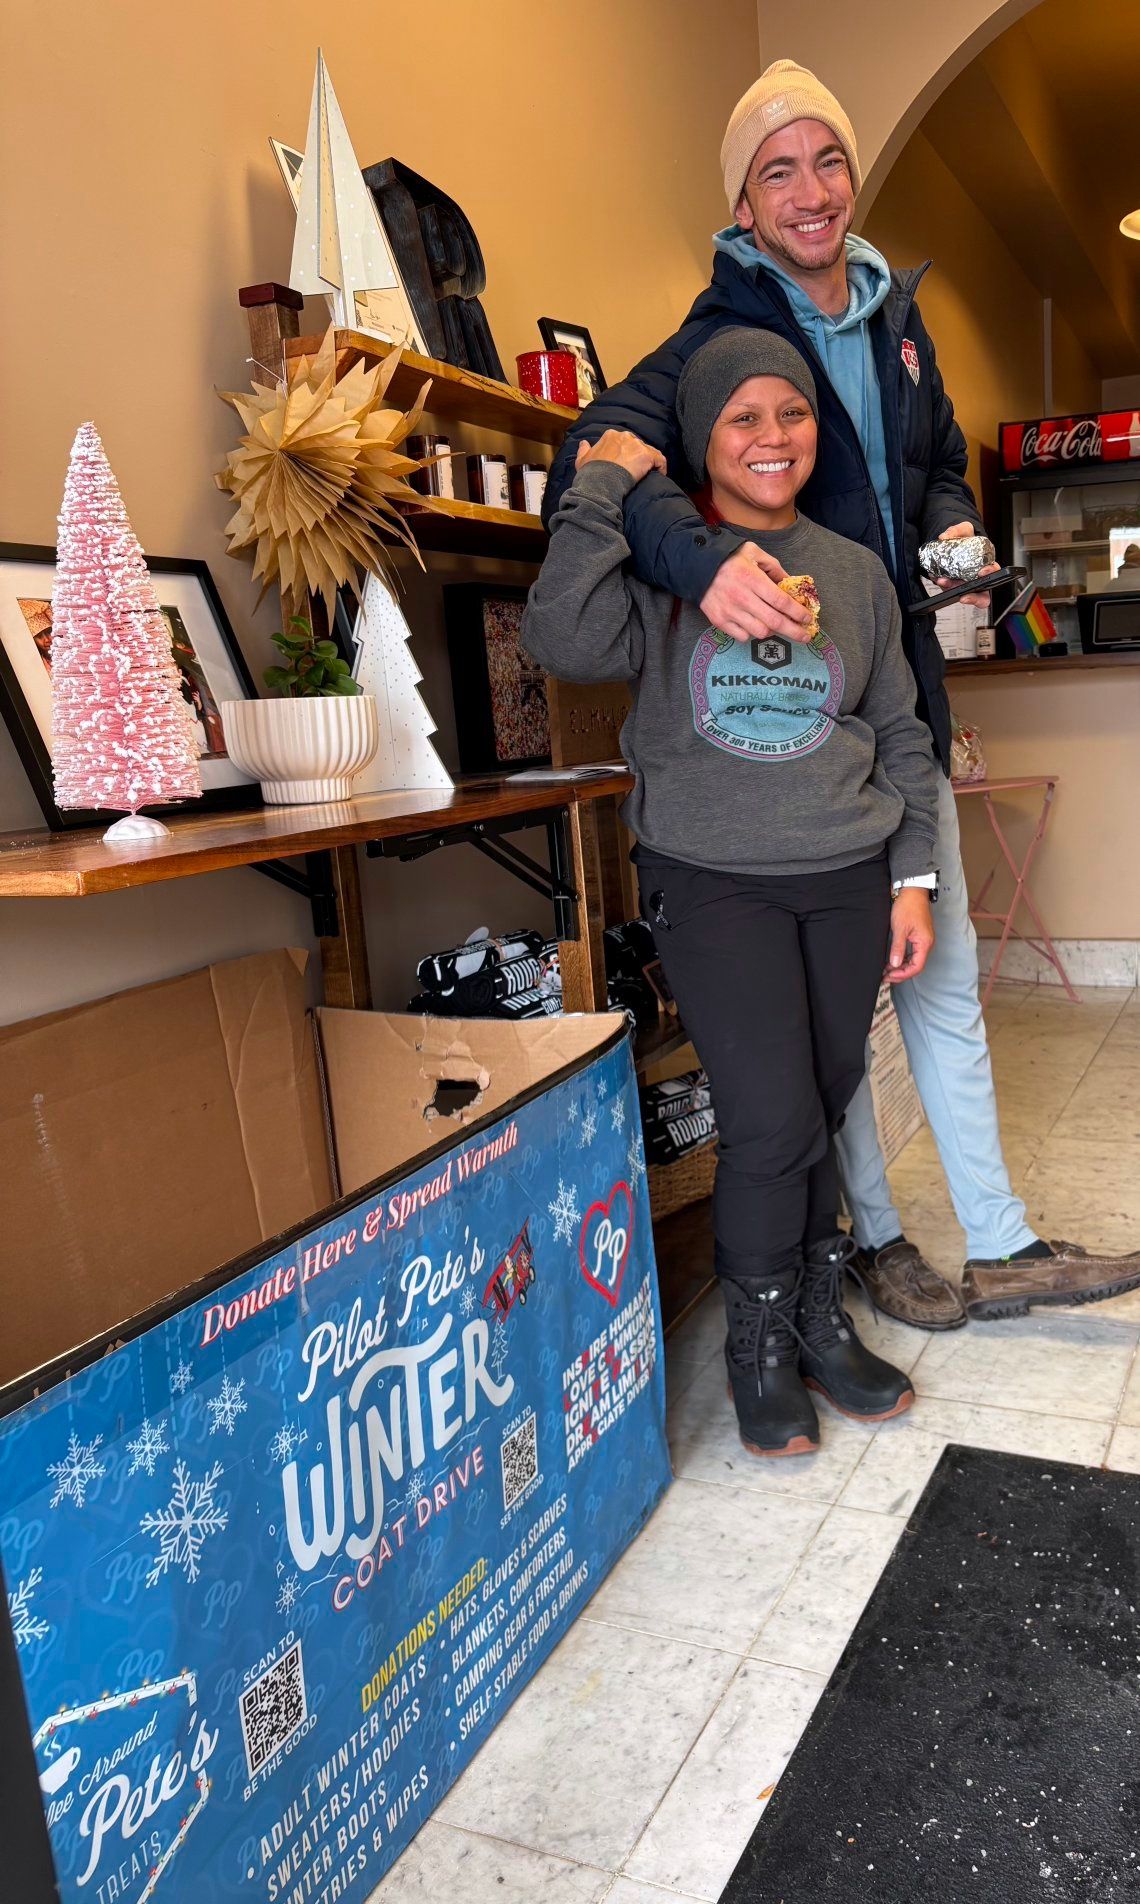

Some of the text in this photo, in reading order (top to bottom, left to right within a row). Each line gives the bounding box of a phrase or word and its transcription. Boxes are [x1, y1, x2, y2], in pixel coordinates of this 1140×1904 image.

[1021, 420, 1102, 466] Coca-Cola
[707, 724, 728, 741] OVER
[729, 737, 745, 748] 300
[748, 742, 777, 753] YEARS
[780, 742, 792, 752] OF
[794, 713, 831, 748] EXCELLENC
[711, 675, 828, 694] KIKKOMAN
[720, 691, 779, 702] NATURALLY
[200, 1121, 518, 1348] Donate Here & Spread Warmth
[297, 1224, 486, 1403] Pilot Pete's
[282, 1312, 515, 1572] WINTER
[502, 1405, 532, 1440] SCAN TO
[332, 1445, 486, 1613] COAT DRIVE
[500, 1473, 545, 1531] SEE THE GOOD
[450, 1599, 480, 1640] HATS,
[482, 1549, 520, 1602] GLOVES
[528, 1492, 567, 1549] SCARVES
[451, 1525, 566, 1675] BLANKETS, COMFORTERS
[242, 1630, 295, 1688] SCAN TO
[361, 1556, 489, 1713] DONATIONS NEEDED:
[455, 1641, 503, 1708] CAMPING
[504, 1608, 527, 1649] GEAR
[535, 1549, 574, 1608] FIRSTAID
[459, 1685, 493, 1741] SHELF
[494, 1643, 528, 1697] STABLE
[528, 1613, 551, 1652] FOOD
[559, 1560, 589, 1610] DRINKS
[76, 1710, 219, 1887] Pete's
[79, 1710, 158, 1795] Around
[243, 1713, 318, 1802] BE THE GOOD
[260, 1654, 427, 1866] ADULT WINTER COATS
[267, 1697, 421, 1902] SWEATERS/HOODIES
[372, 1826, 382, 1852] &
[386, 1764, 429, 1834] WIPES
[95, 1830, 163, 1904] TREATS
[336, 1780, 387, 1854] BOOTS
